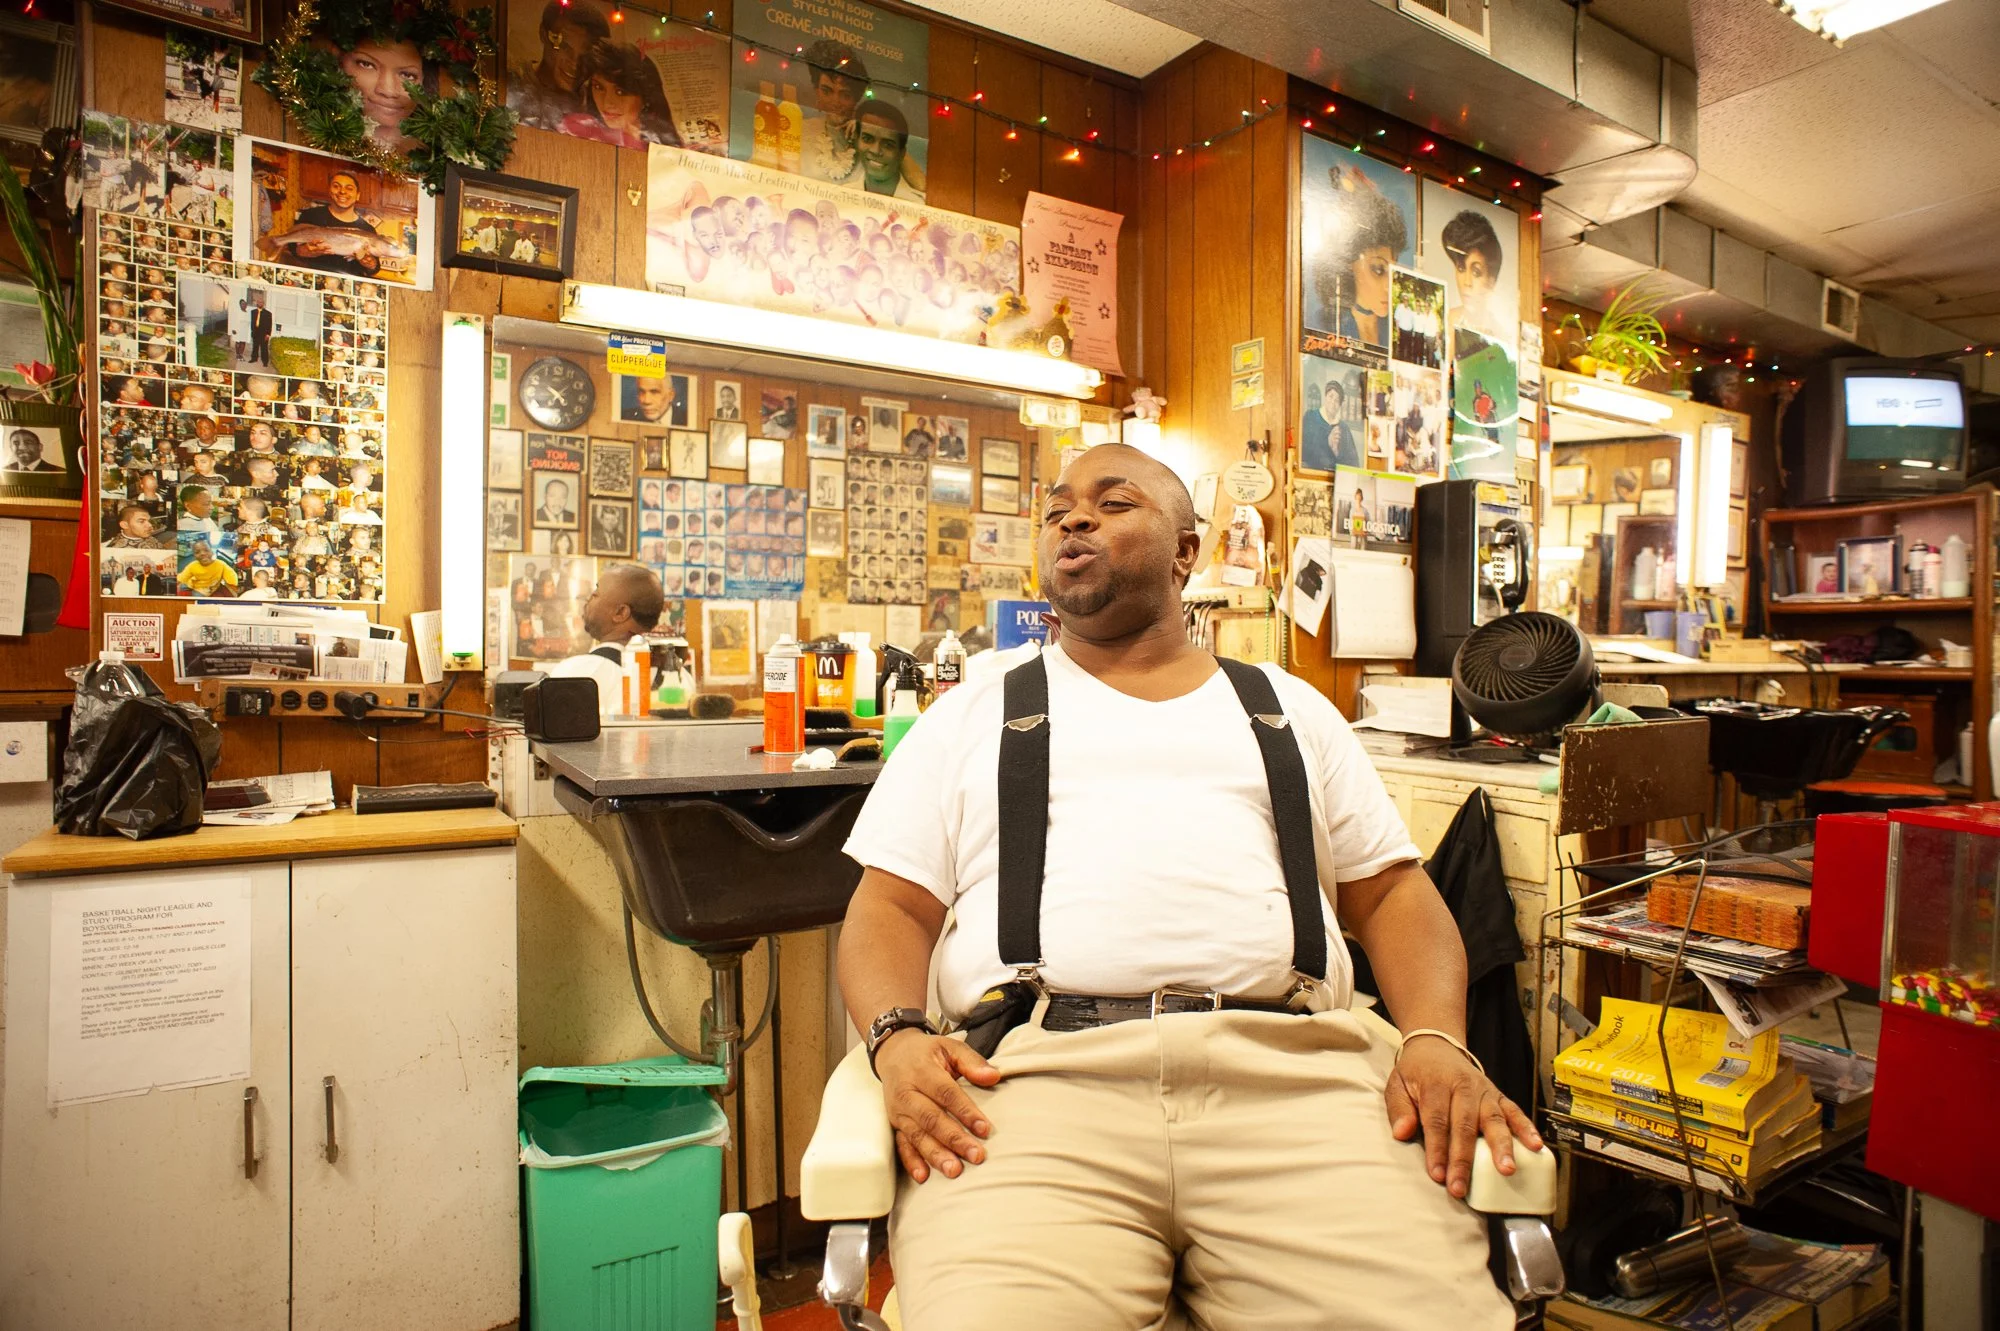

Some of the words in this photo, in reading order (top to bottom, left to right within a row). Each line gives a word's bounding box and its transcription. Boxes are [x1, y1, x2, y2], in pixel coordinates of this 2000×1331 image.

[792, 0, 829, 17] STYLES
[831, 10, 844, 20] IN
[845, 15, 874, 31] HOLD
[846, 4, 874, 19] BODY
[766, 8, 812, 33] CREME
[822, 24, 865, 49] NATURE
[865, 43, 904, 63] MOUSSE
[678, 154, 720, 174] Harlem
[724, 163, 755, 181] Music
[758, 172, 800, 192] Festival
[841, 191, 858, 206] THE
[863, 196, 886, 211] 100th
[888, 202, 960, 229] ANNIVERSARY
[962, 219, 976, 233] OF
[977, 223, 998, 236] JAZZ
[1067, 232, 1075, 244] A
[1049, 241, 1092, 261] FANTASY
[611, 354, 663, 369] CLIPPERCIDE
[112, 619, 156, 627] AUCTION
[1016, 610, 1044, 626] POL
[82, 908, 134, 918] BASKETBALL
[137, 905, 162, 914] NIGHT
[164, 903, 194, 912] LEAGUE
[197, 901, 213, 909] AND
[82, 918, 110, 926] STUDY
[112, 914, 154, 924] PROGRAM
[157, 911, 173, 919] FOR
[143, 965, 181, 973] MALDONADO
[1563, 1055, 1605, 1073] 2011
[1610, 1066, 1657, 1086] 2012
